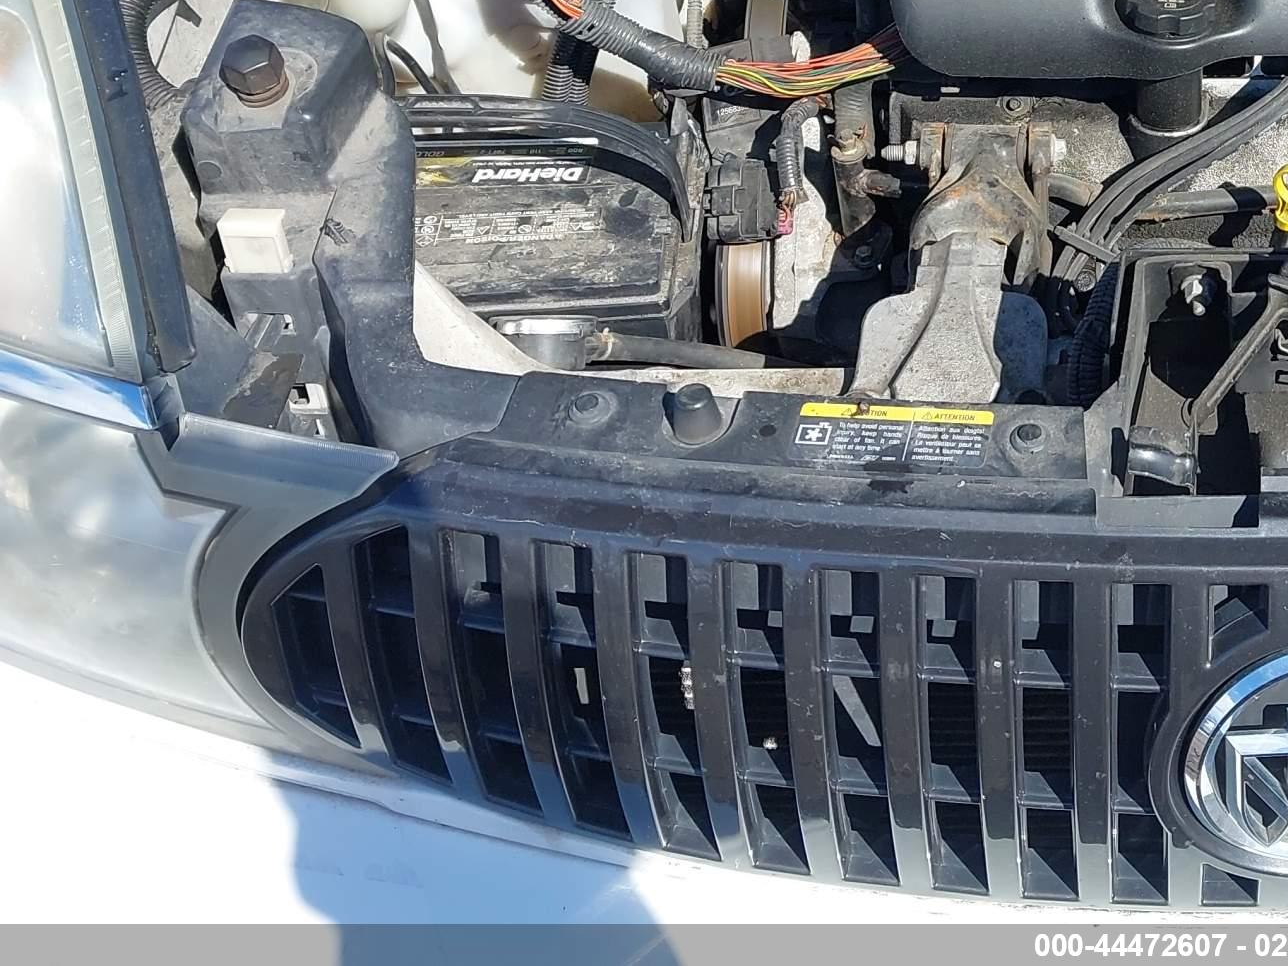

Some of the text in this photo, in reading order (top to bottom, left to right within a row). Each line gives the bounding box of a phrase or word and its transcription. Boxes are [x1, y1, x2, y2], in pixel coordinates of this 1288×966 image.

[471, 166, 585, 184] DieHard
[934, 413, 976, 421] ATTENTION
[847, 422, 861, 430] help
